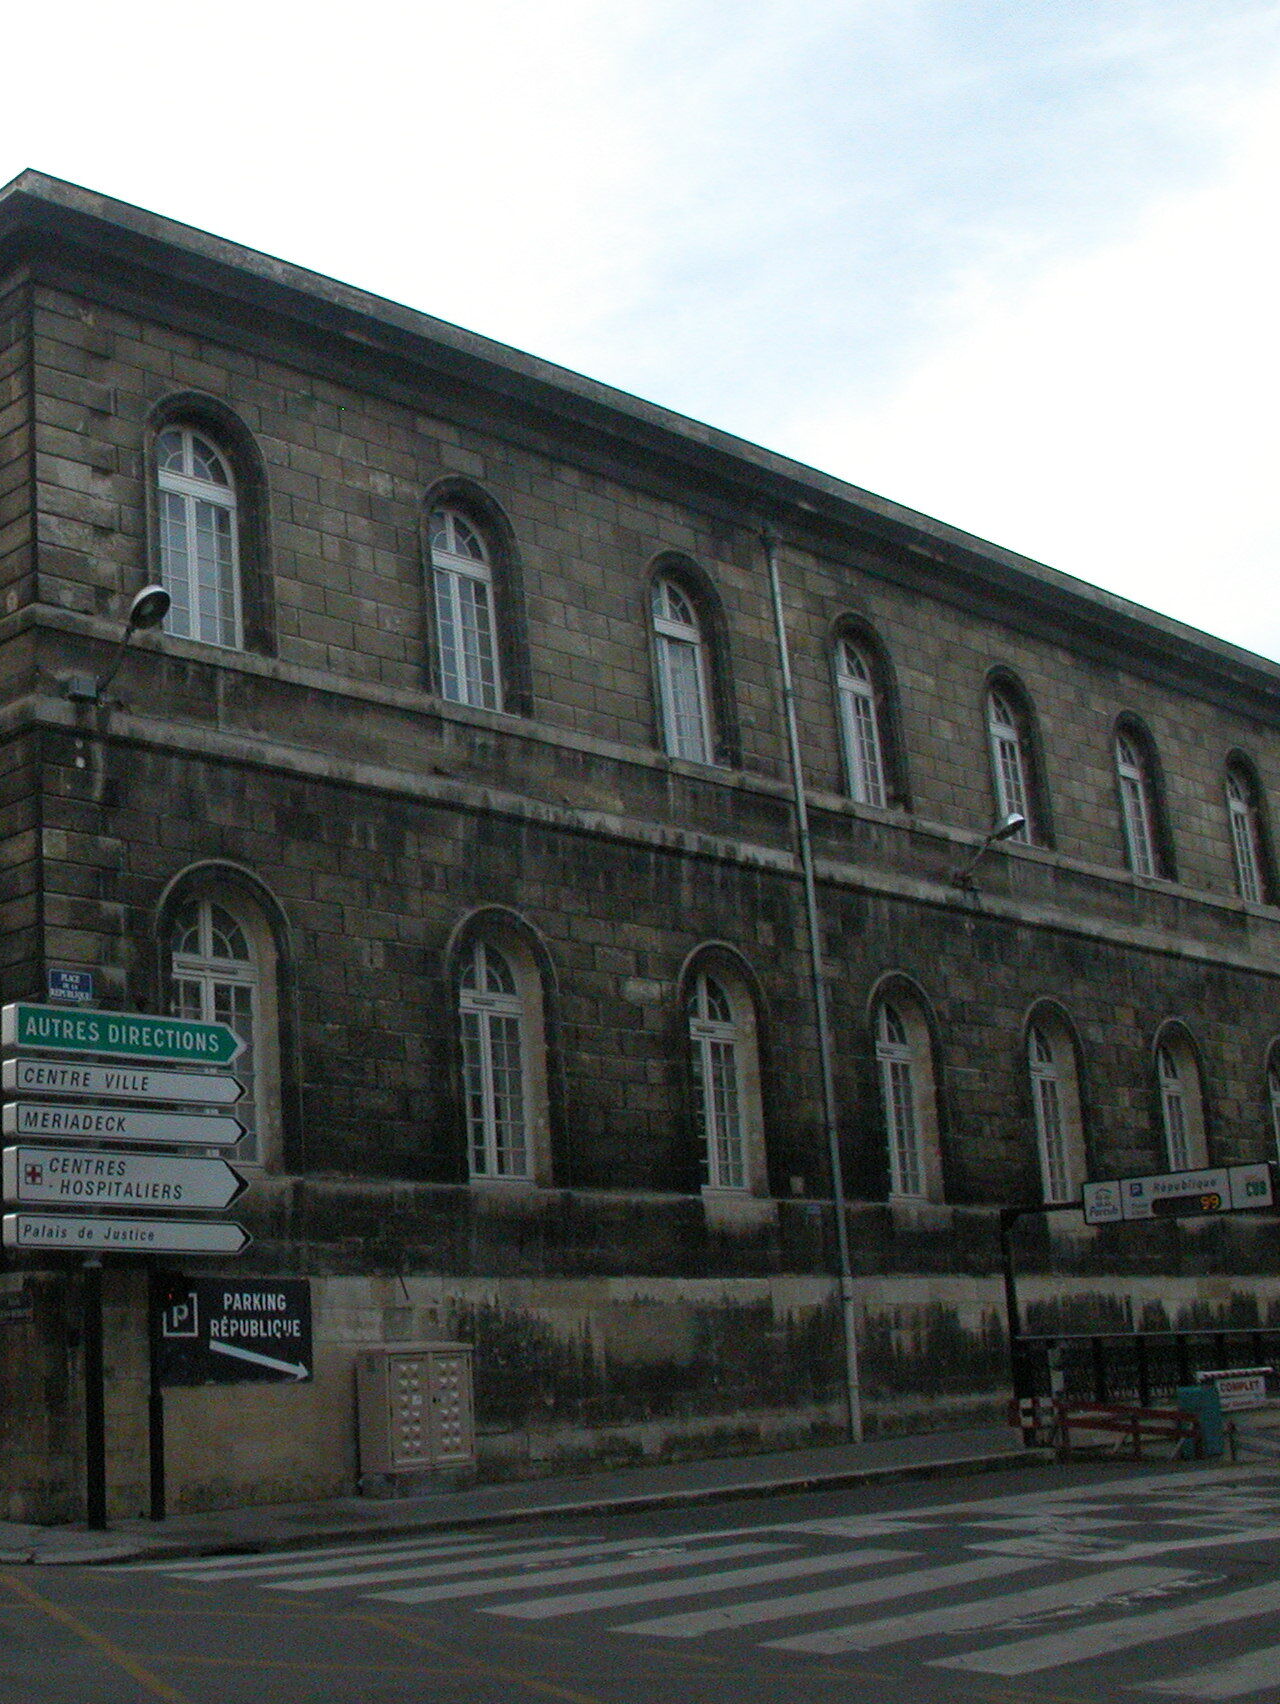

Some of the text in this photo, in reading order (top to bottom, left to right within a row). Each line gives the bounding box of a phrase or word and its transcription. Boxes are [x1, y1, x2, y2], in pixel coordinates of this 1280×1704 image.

[61, 973, 80, 983] PLACE
[26, 1016, 220, 1053] AUTRES DIRECTIONS
[24, 1067, 150, 1091] CENTRE VILLE
[24, 1111, 127, 1132] MERIADECK
[49, 1157, 126, 1176] CENTRES
[60, 1179, 183, 1199] HOSPITALIERS
[1153, 1177, 1218, 1193] République
[1200, 1194, 1219, 1210] 99
[23, 1224, 155, 1241] Palais de Justice
[223, 1292, 287, 1312] PARKING
[173, 1304, 189, 1328] P
[210, 1316, 302, 1339] RÉPUBLIQUE
[1219, 1379, 1259, 1393] COMPLET
